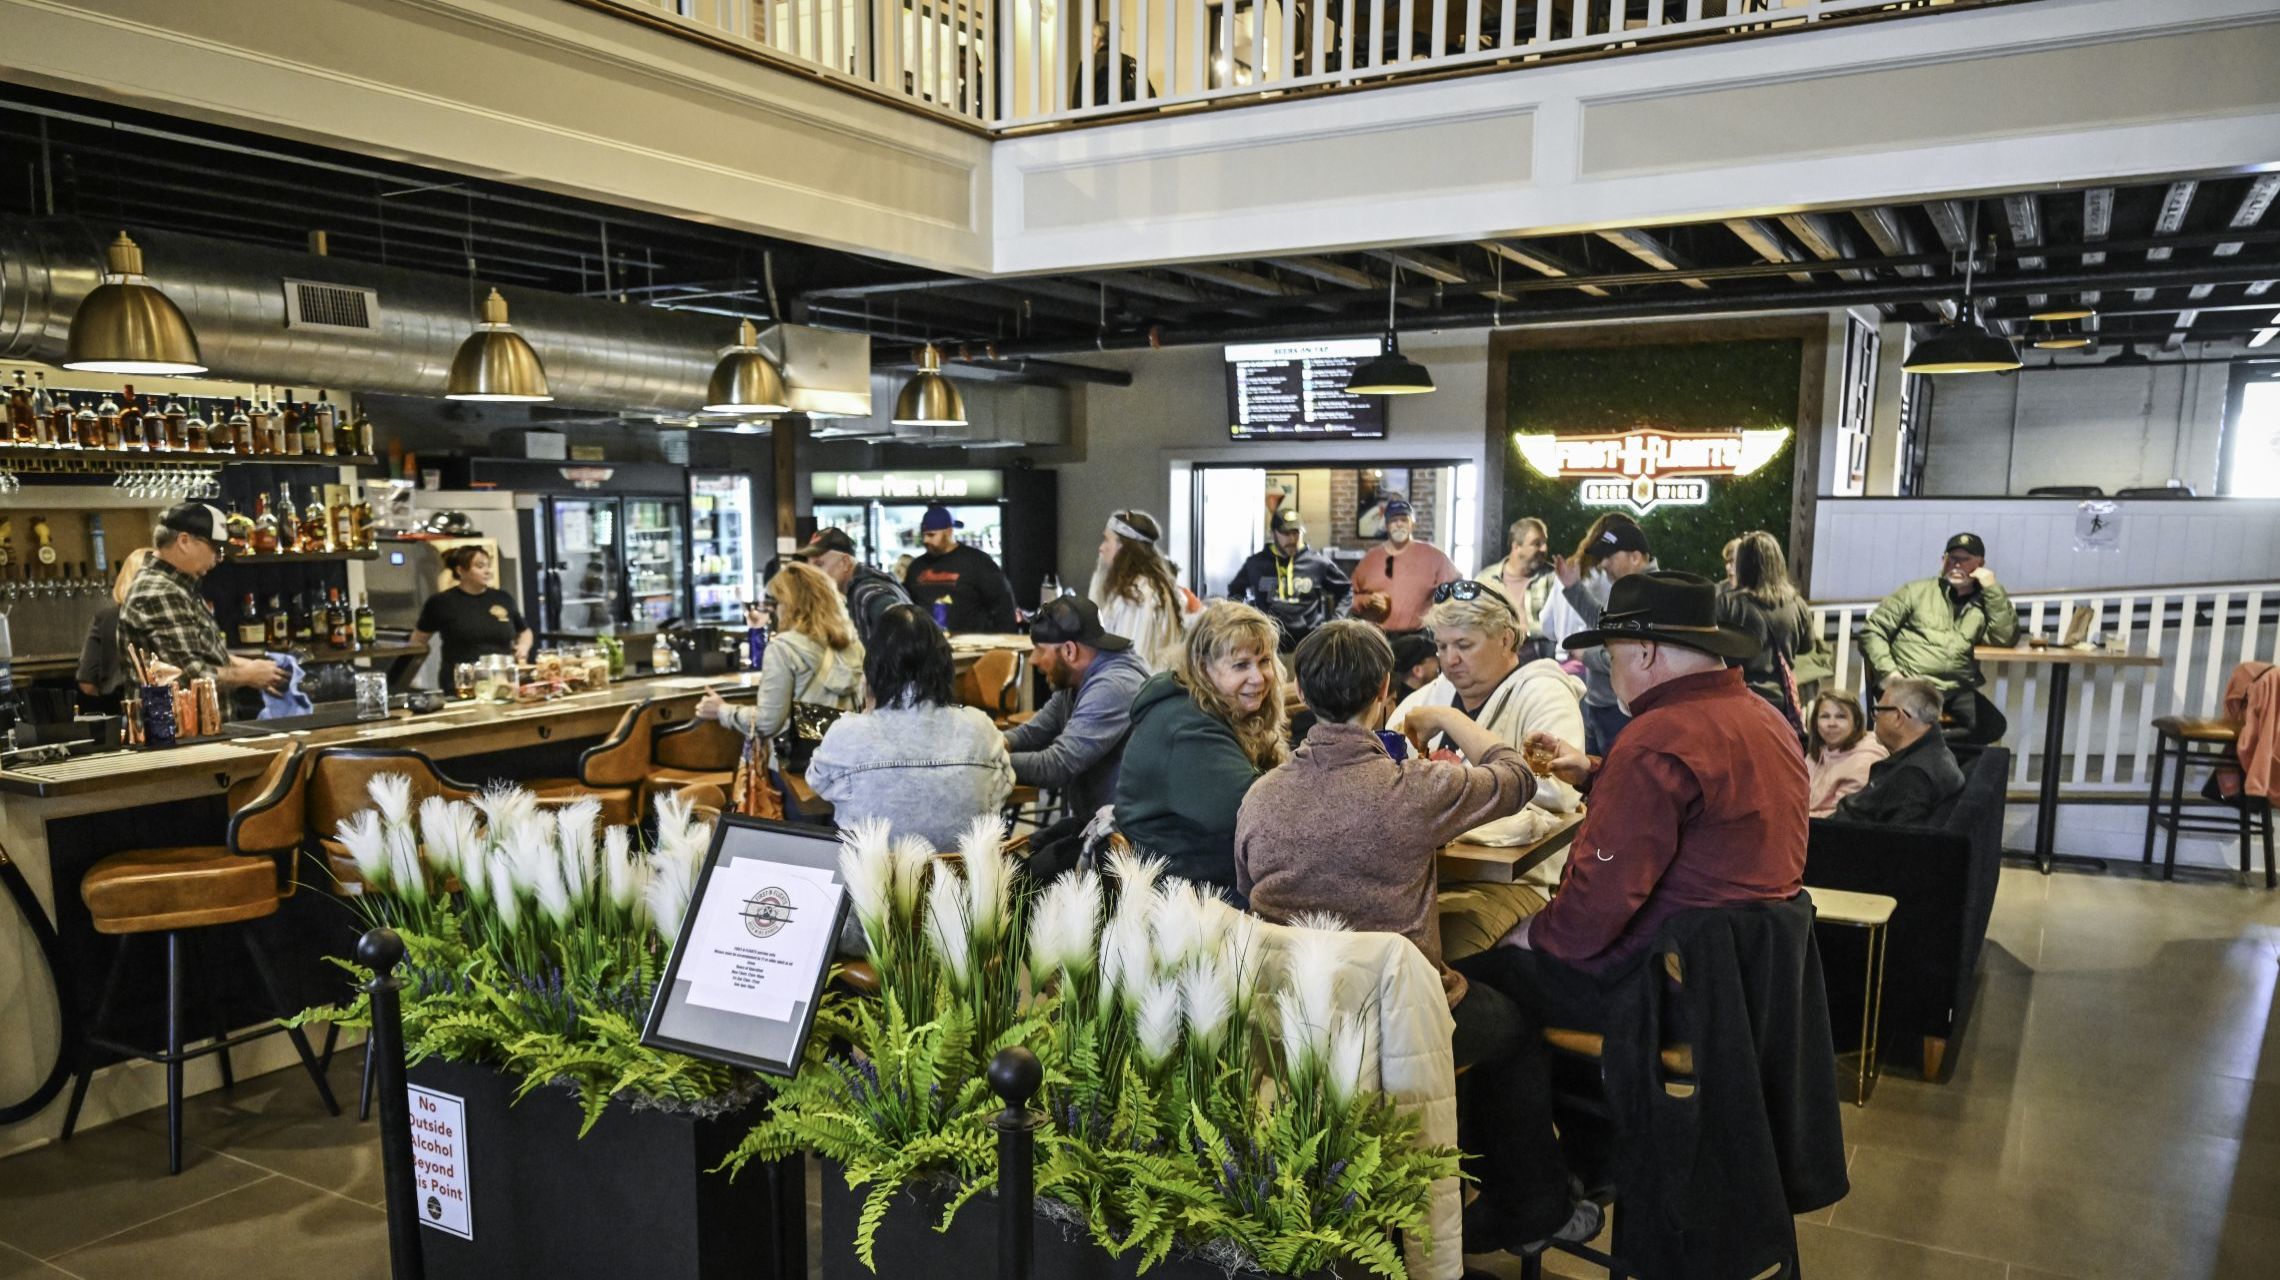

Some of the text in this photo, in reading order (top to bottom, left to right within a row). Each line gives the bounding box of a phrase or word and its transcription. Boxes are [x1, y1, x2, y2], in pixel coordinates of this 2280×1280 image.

[1589, 485, 1698, 499] BEER WINE
[419, 1096, 437, 1113] No
[416, 1174, 464, 1202] is Point
